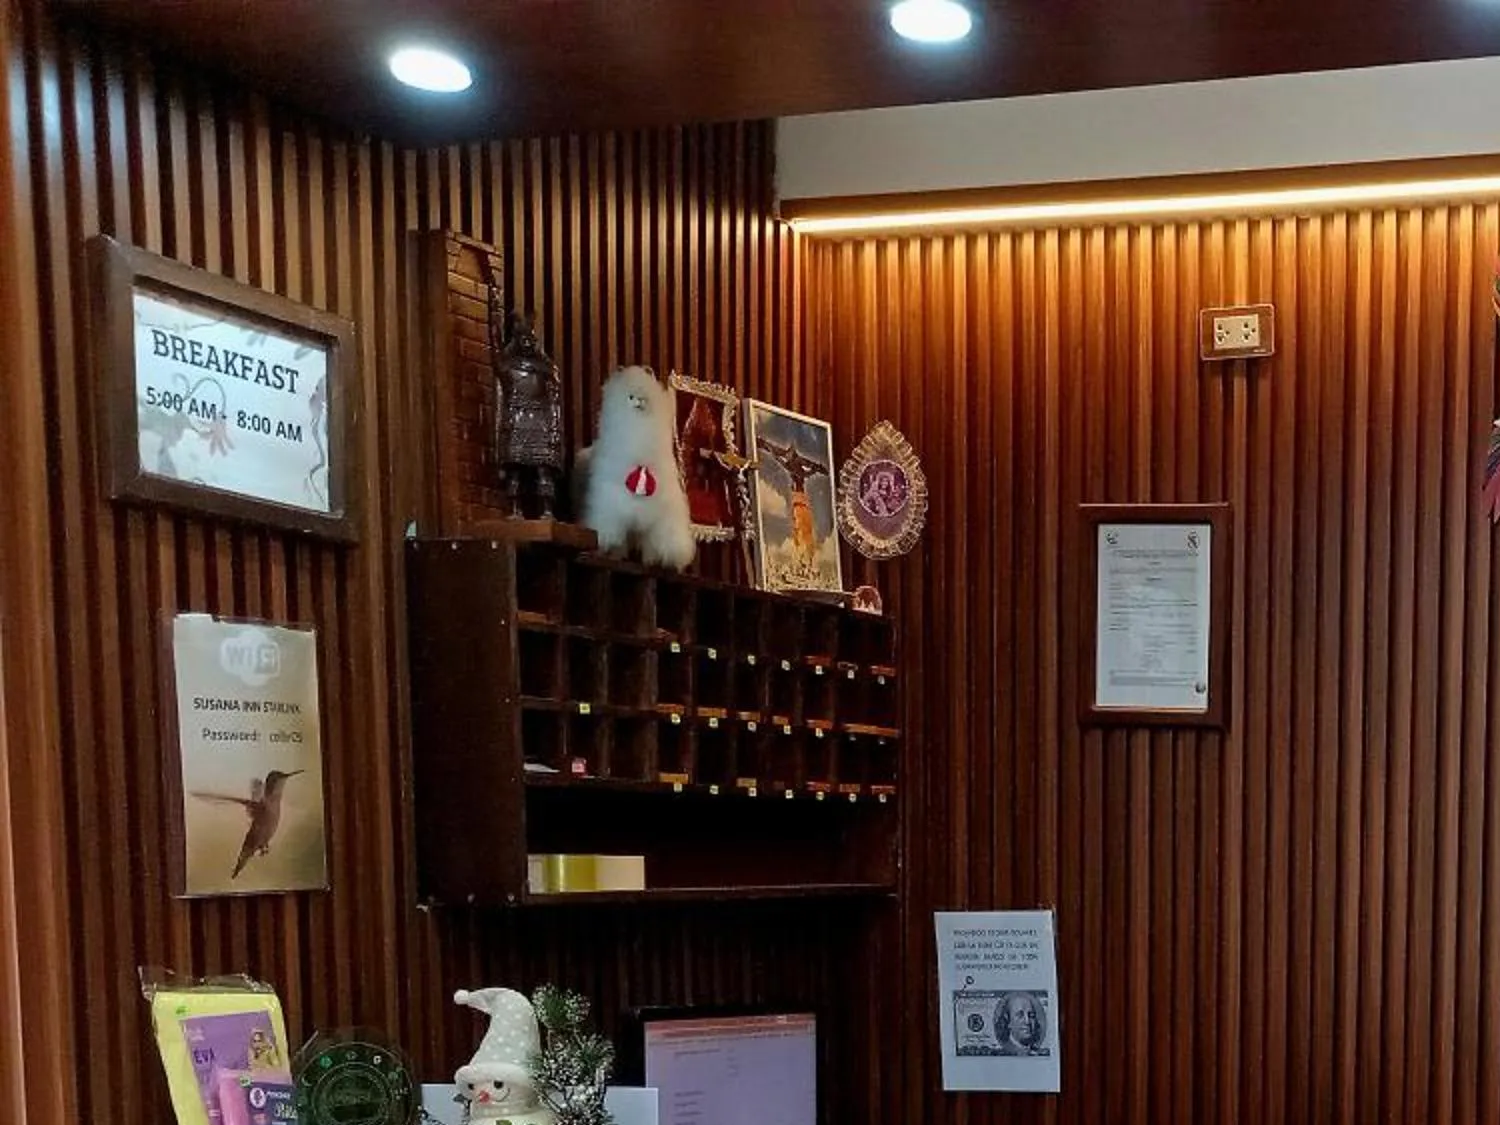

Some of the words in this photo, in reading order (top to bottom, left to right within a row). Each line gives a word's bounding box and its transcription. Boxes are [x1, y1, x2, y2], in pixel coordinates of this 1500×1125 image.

[151, 329, 299, 394] BREAKFAST
[145, 386, 183, 412] 5:00
[187, 398, 217, 421] AM
[236, 410, 271, 434] 8:00
[275, 421, 303, 443] AM
[193, 697, 240, 712] SUSANA
